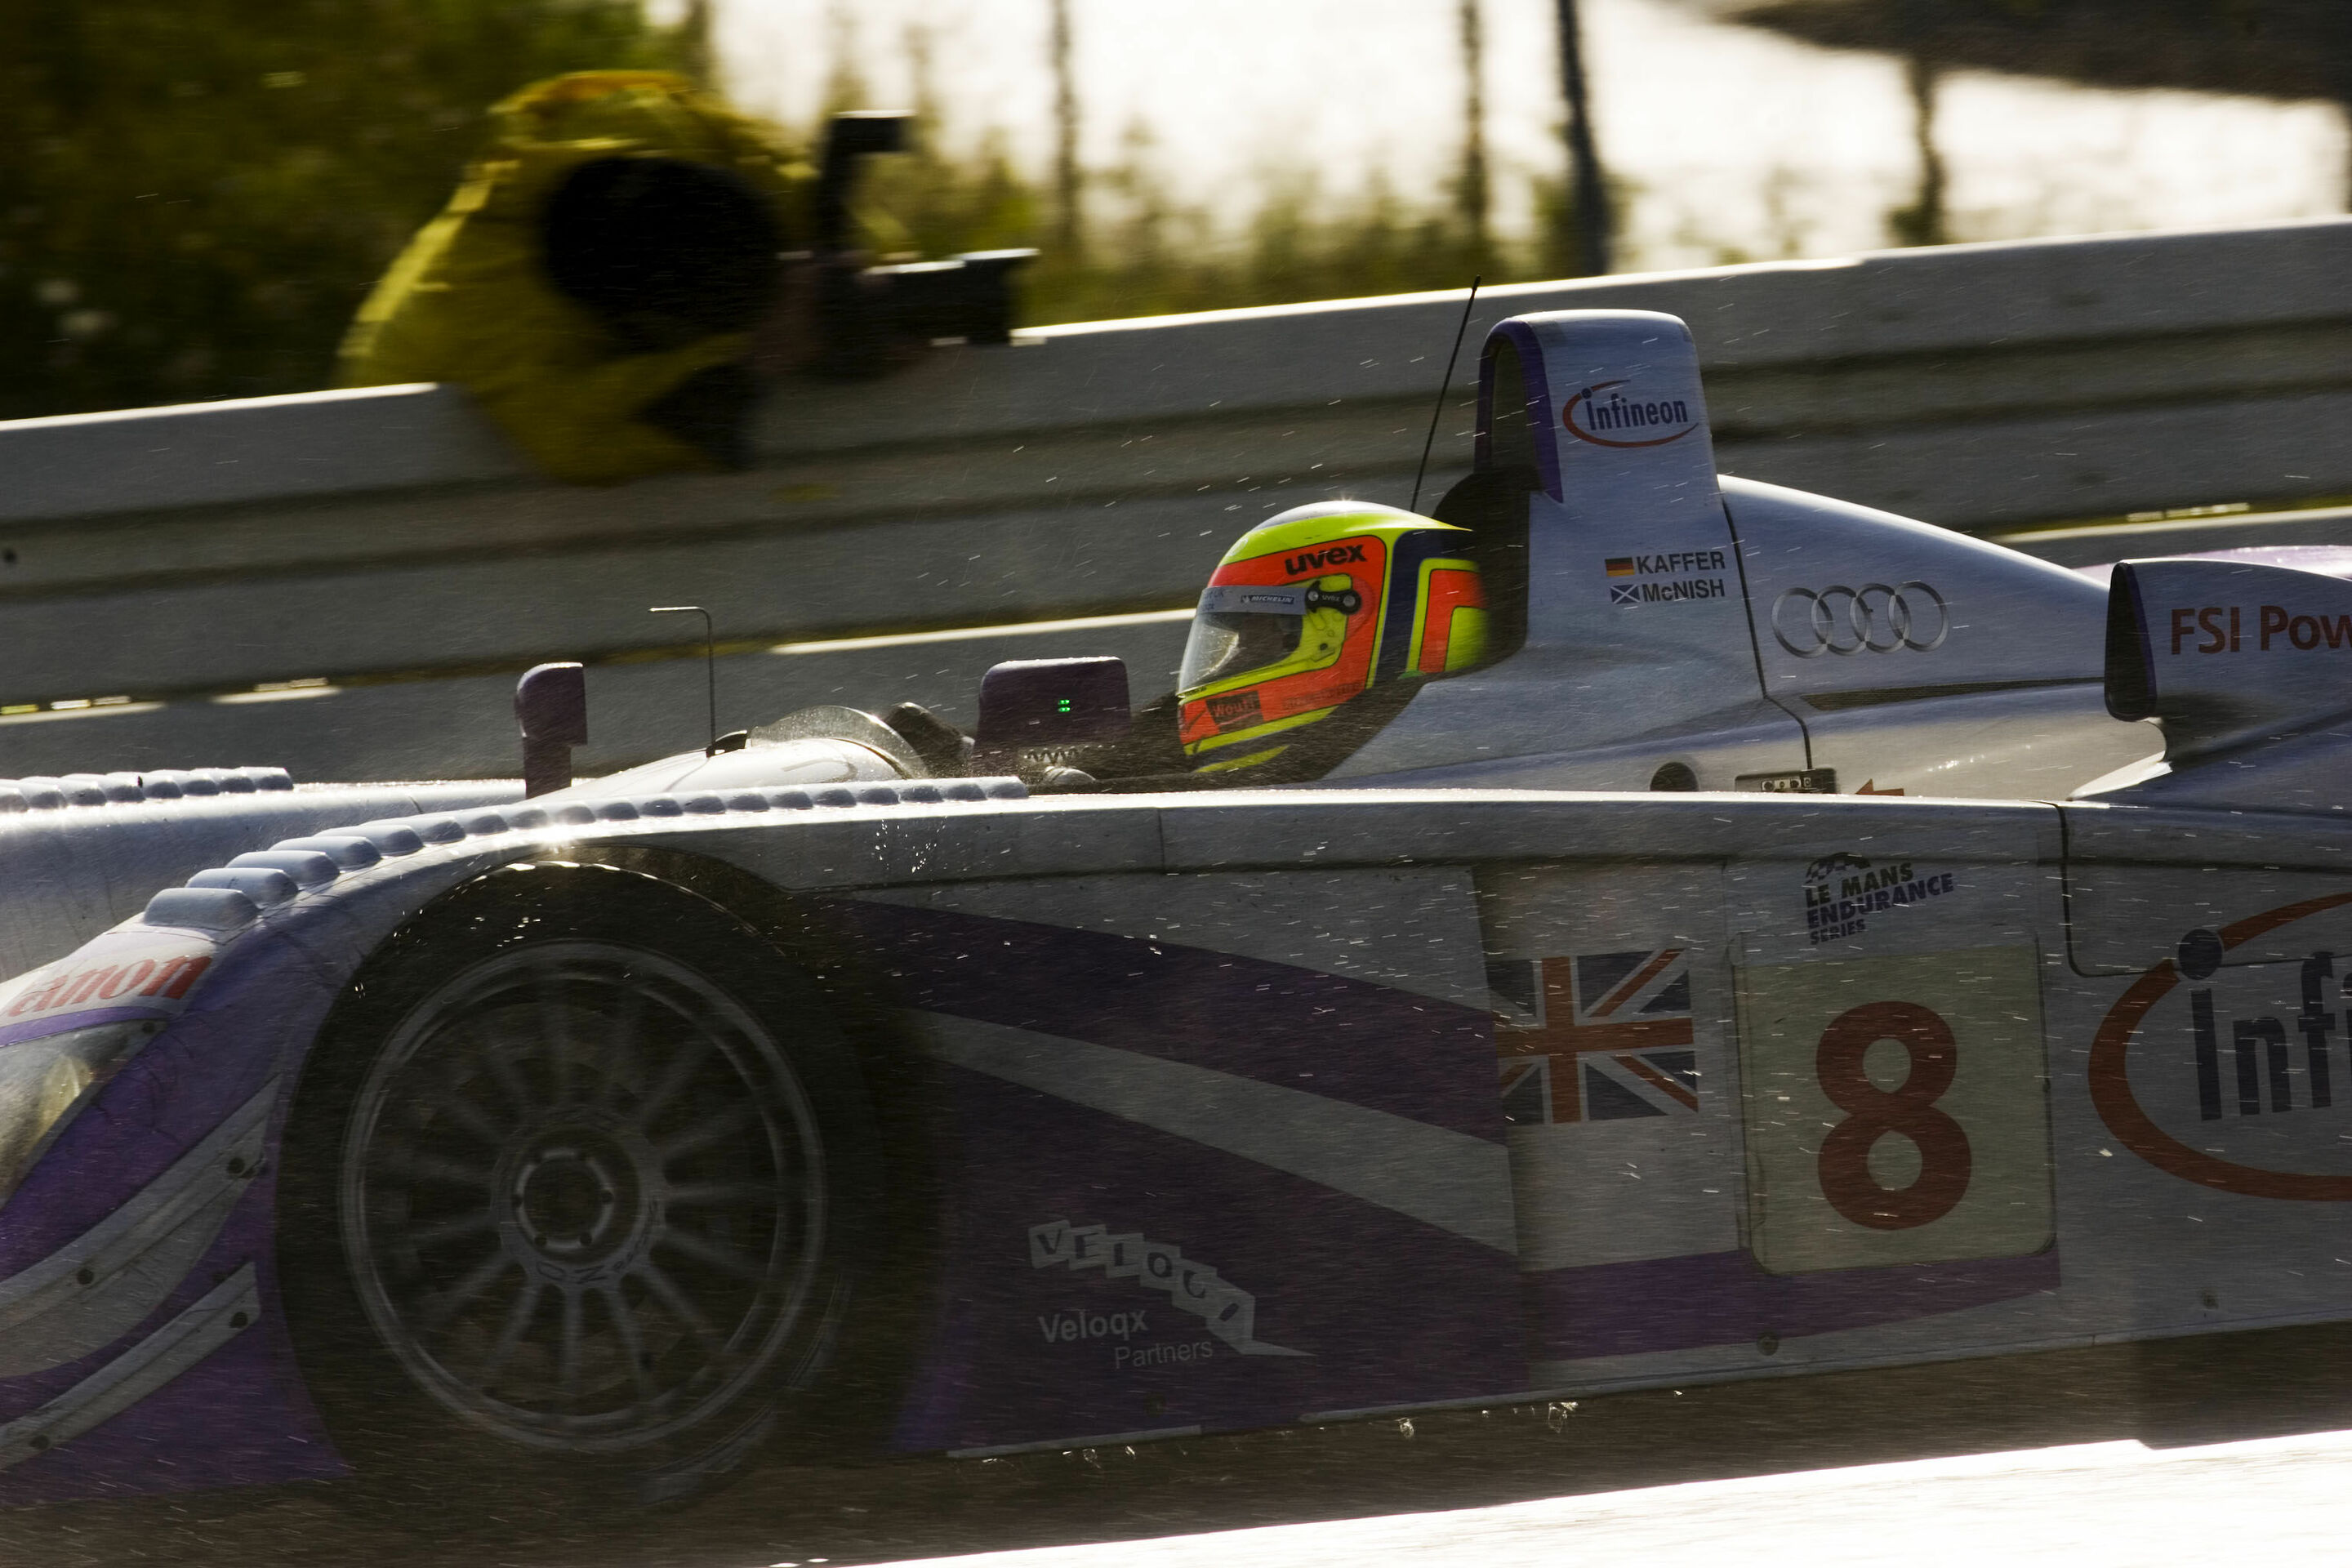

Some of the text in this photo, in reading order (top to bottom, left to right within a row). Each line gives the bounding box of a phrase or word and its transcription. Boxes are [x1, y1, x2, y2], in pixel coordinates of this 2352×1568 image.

[1285, 543, 1366, 575] uvex
[1637, 550, 1726, 574] KAFFER
[1250, 595, 1293, 604] MICHELIN
[1642, 578, 1725, 603] McNISH
[2171, 606, 2240, 655] FSI
[1805, 862, 1914, 906] LE MANS
[1806, 872, 1954, 929] ENDURANCE
[1810, 918, 1866, 946] SERIES
[1815, 1000, 1972, 1231] 8
[1038, 1308, 1149, 1343] Veloqx
[1114, 1340, 1214, 1370] Partners
